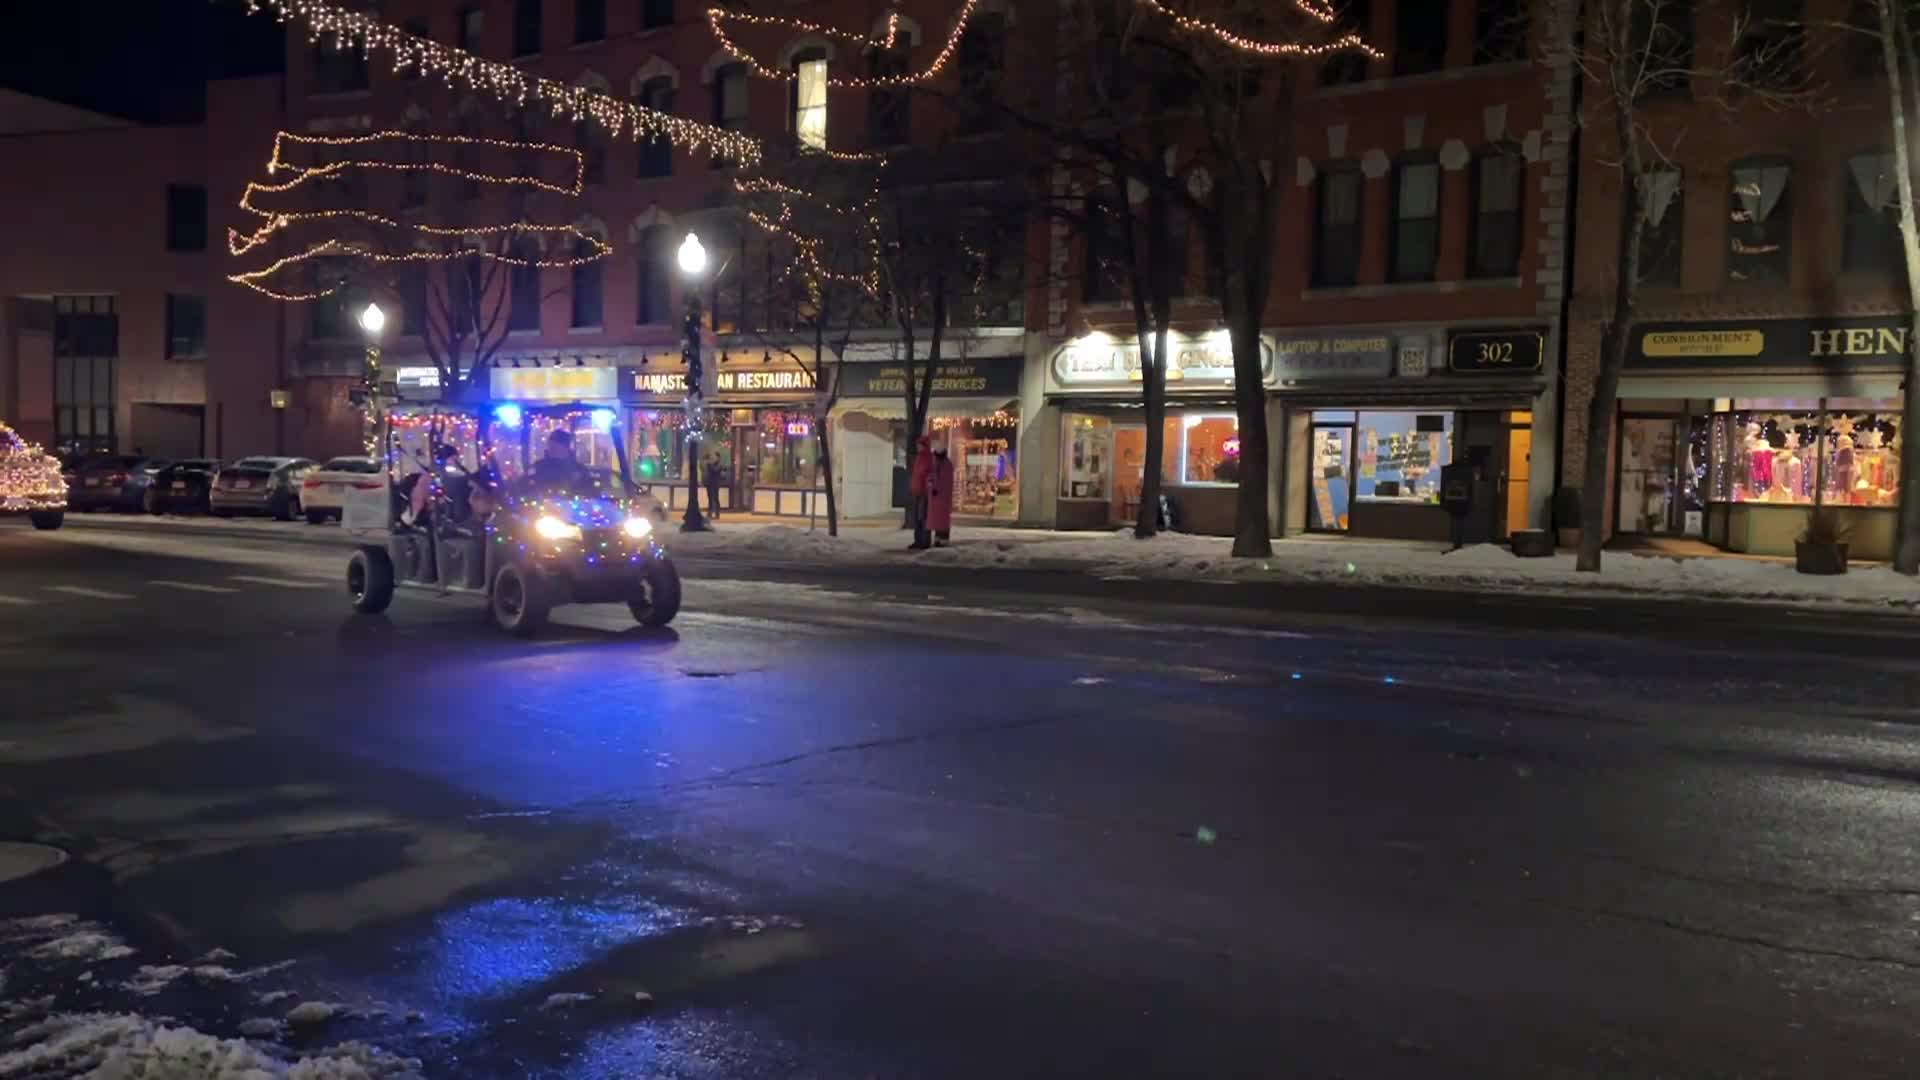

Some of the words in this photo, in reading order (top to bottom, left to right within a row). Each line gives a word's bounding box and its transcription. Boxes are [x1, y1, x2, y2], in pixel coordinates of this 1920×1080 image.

[1279, 340, 1319, 353] LAPTOP
[1334, 337, 1387, 352] COMPUTER
[1809, 326, 1914, 356] HEN
[1479, 342, 1513, 362] 302
[717, 372, 734, 390] AN
[931, 376, 987, 391] SERVICES
